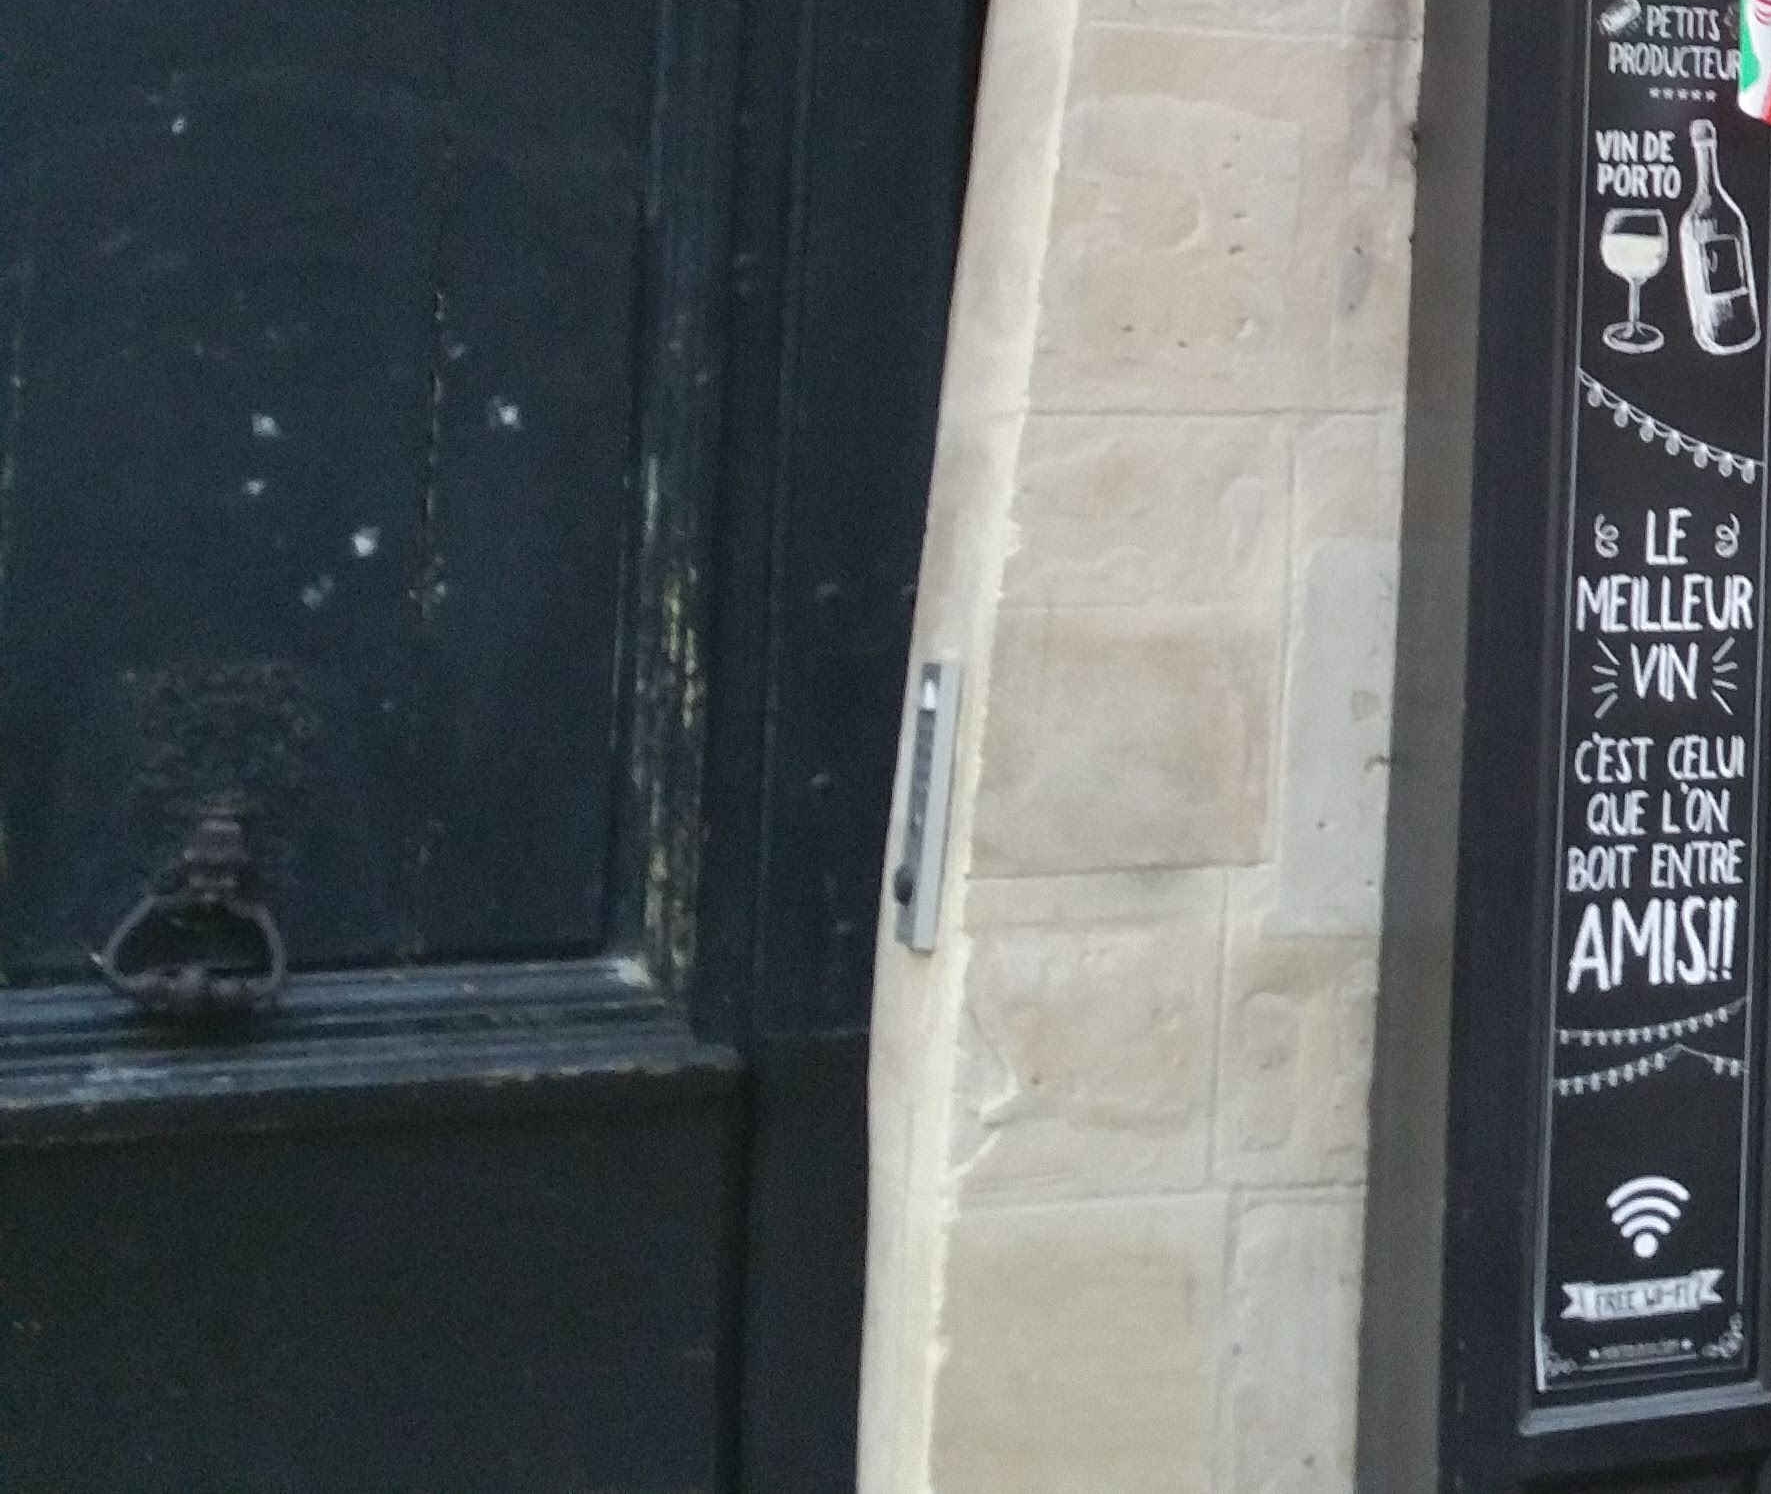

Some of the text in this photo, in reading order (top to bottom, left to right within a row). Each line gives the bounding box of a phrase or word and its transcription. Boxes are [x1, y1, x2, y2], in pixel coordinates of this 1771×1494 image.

[1646, 5, 1720, 42] PETITS
[1607, 41, 1741, 81] PRODUCTEUR
[1595, 130, 1676, 163] VIN DE
[1597, 162, 1682, 199] PORTO
[1645, 507, 1692, 565] LE
[1576, 574, 1753, 633] MEILLEUR
[1630, 642, 1698, 702] VIN
[1574, 731, 1746, 785] C'EST CELUI
[1586, 781, 1731, 837] QUE L'ON
[1566, 837, 1746, 893] BOIT ENTRE
[1566, 894, 1739, 994] AMIS!!
